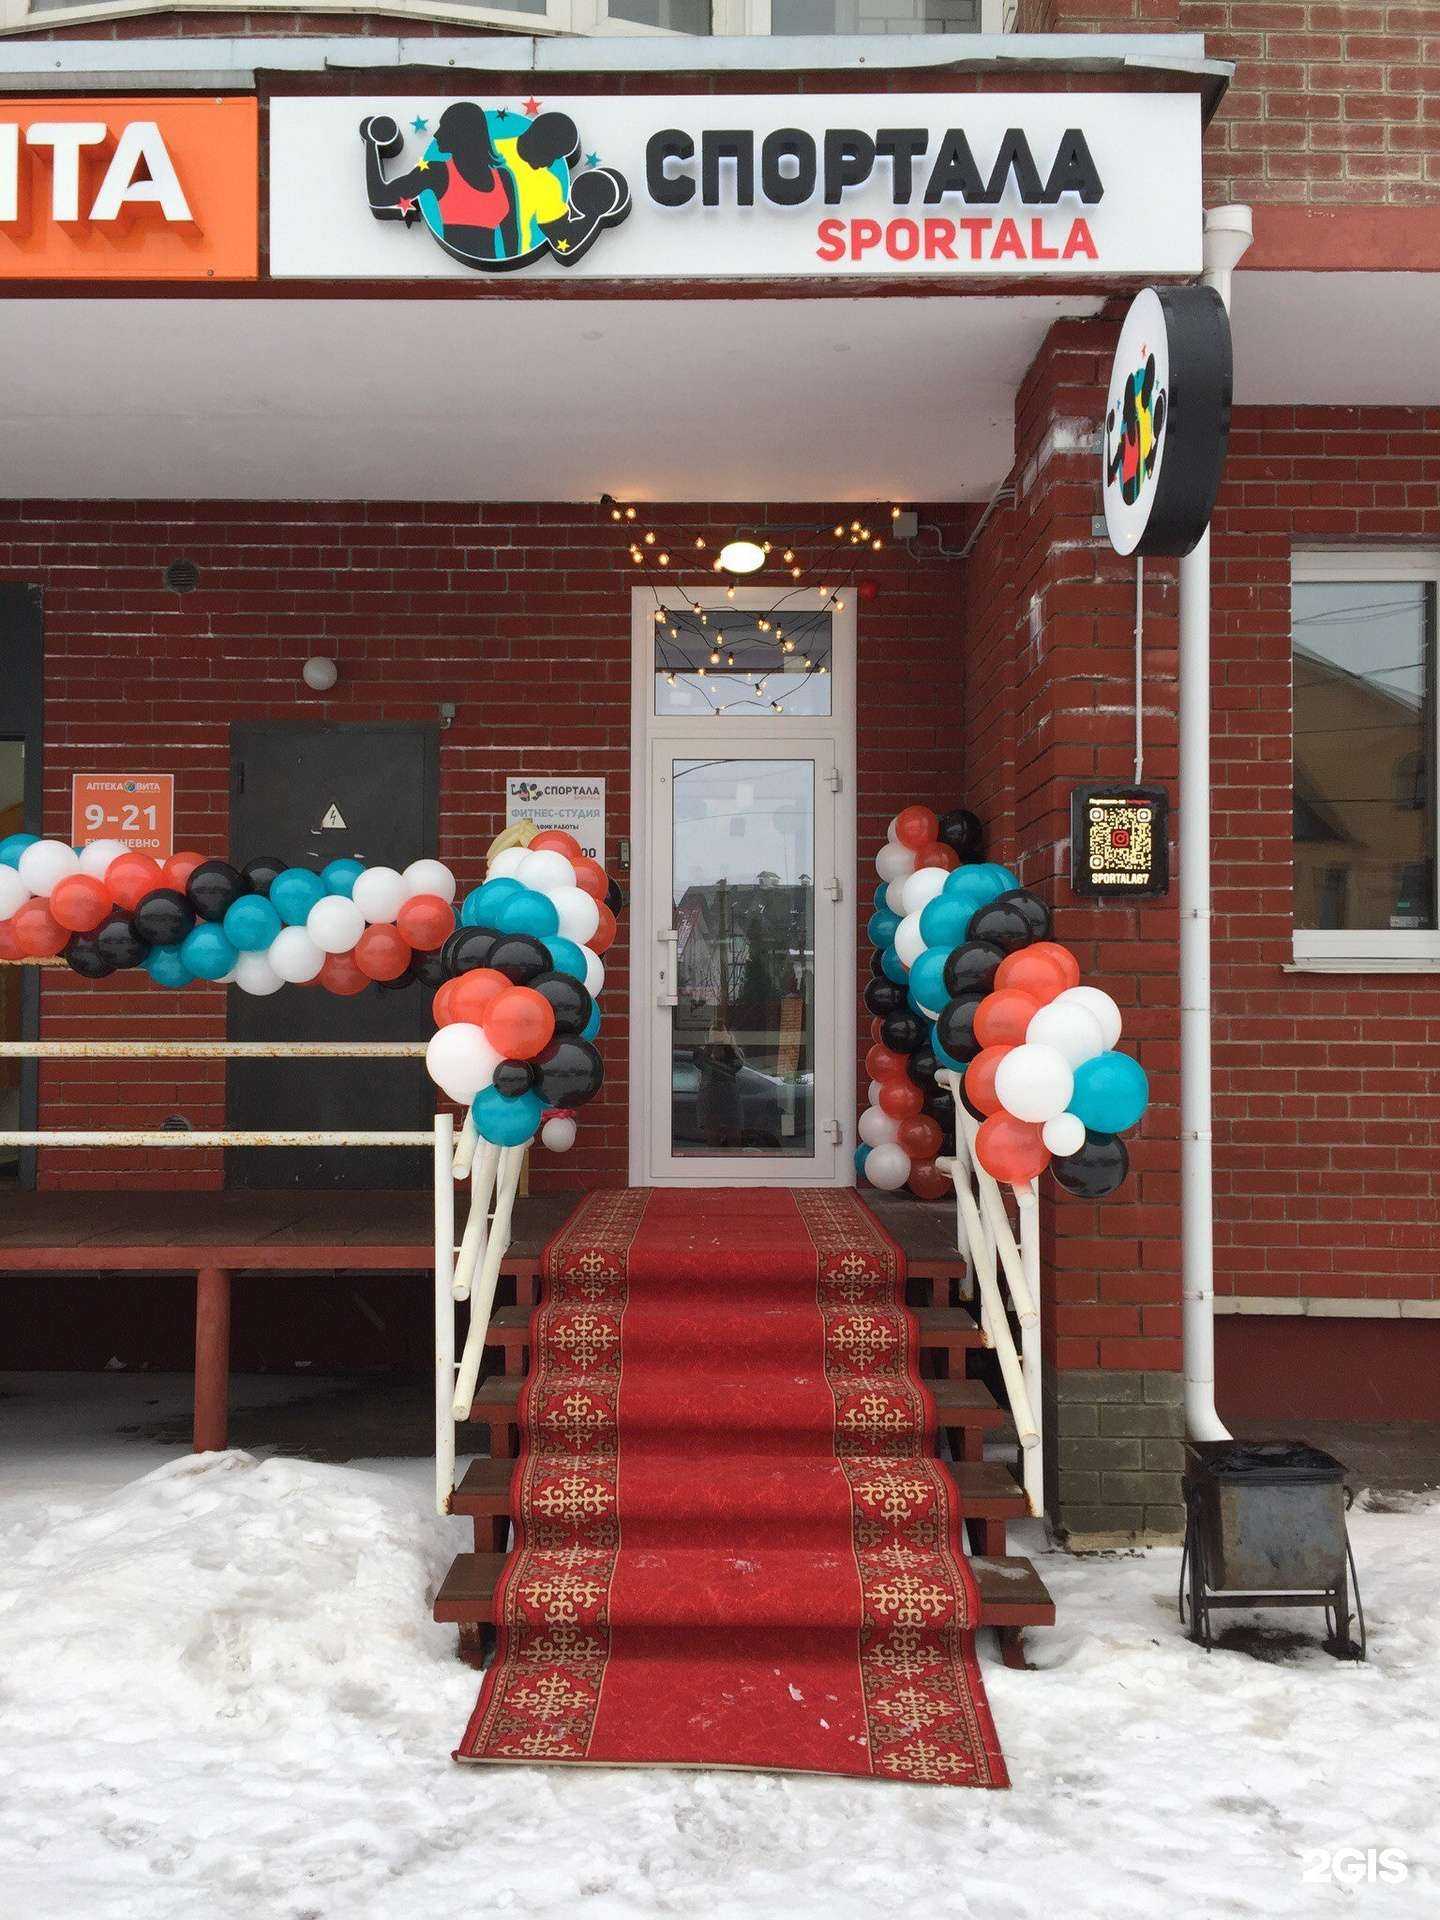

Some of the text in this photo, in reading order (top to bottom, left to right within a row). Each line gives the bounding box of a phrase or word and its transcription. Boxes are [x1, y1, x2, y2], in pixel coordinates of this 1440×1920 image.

[0, 122, 194, 221] ТА
[646, 128, 1104, 207] СПОРТАЛА
[816, 218, 1099, 262] SPORTALA
[86, 782, 161, 791] АПТЕКА ВИТА
[544, 786, 600, 795] СПОРТАЛА
[85, 804, 157, 831] 9-21
[511, 807, 600, 819] ФИТНЕС-СТУДИЯ
